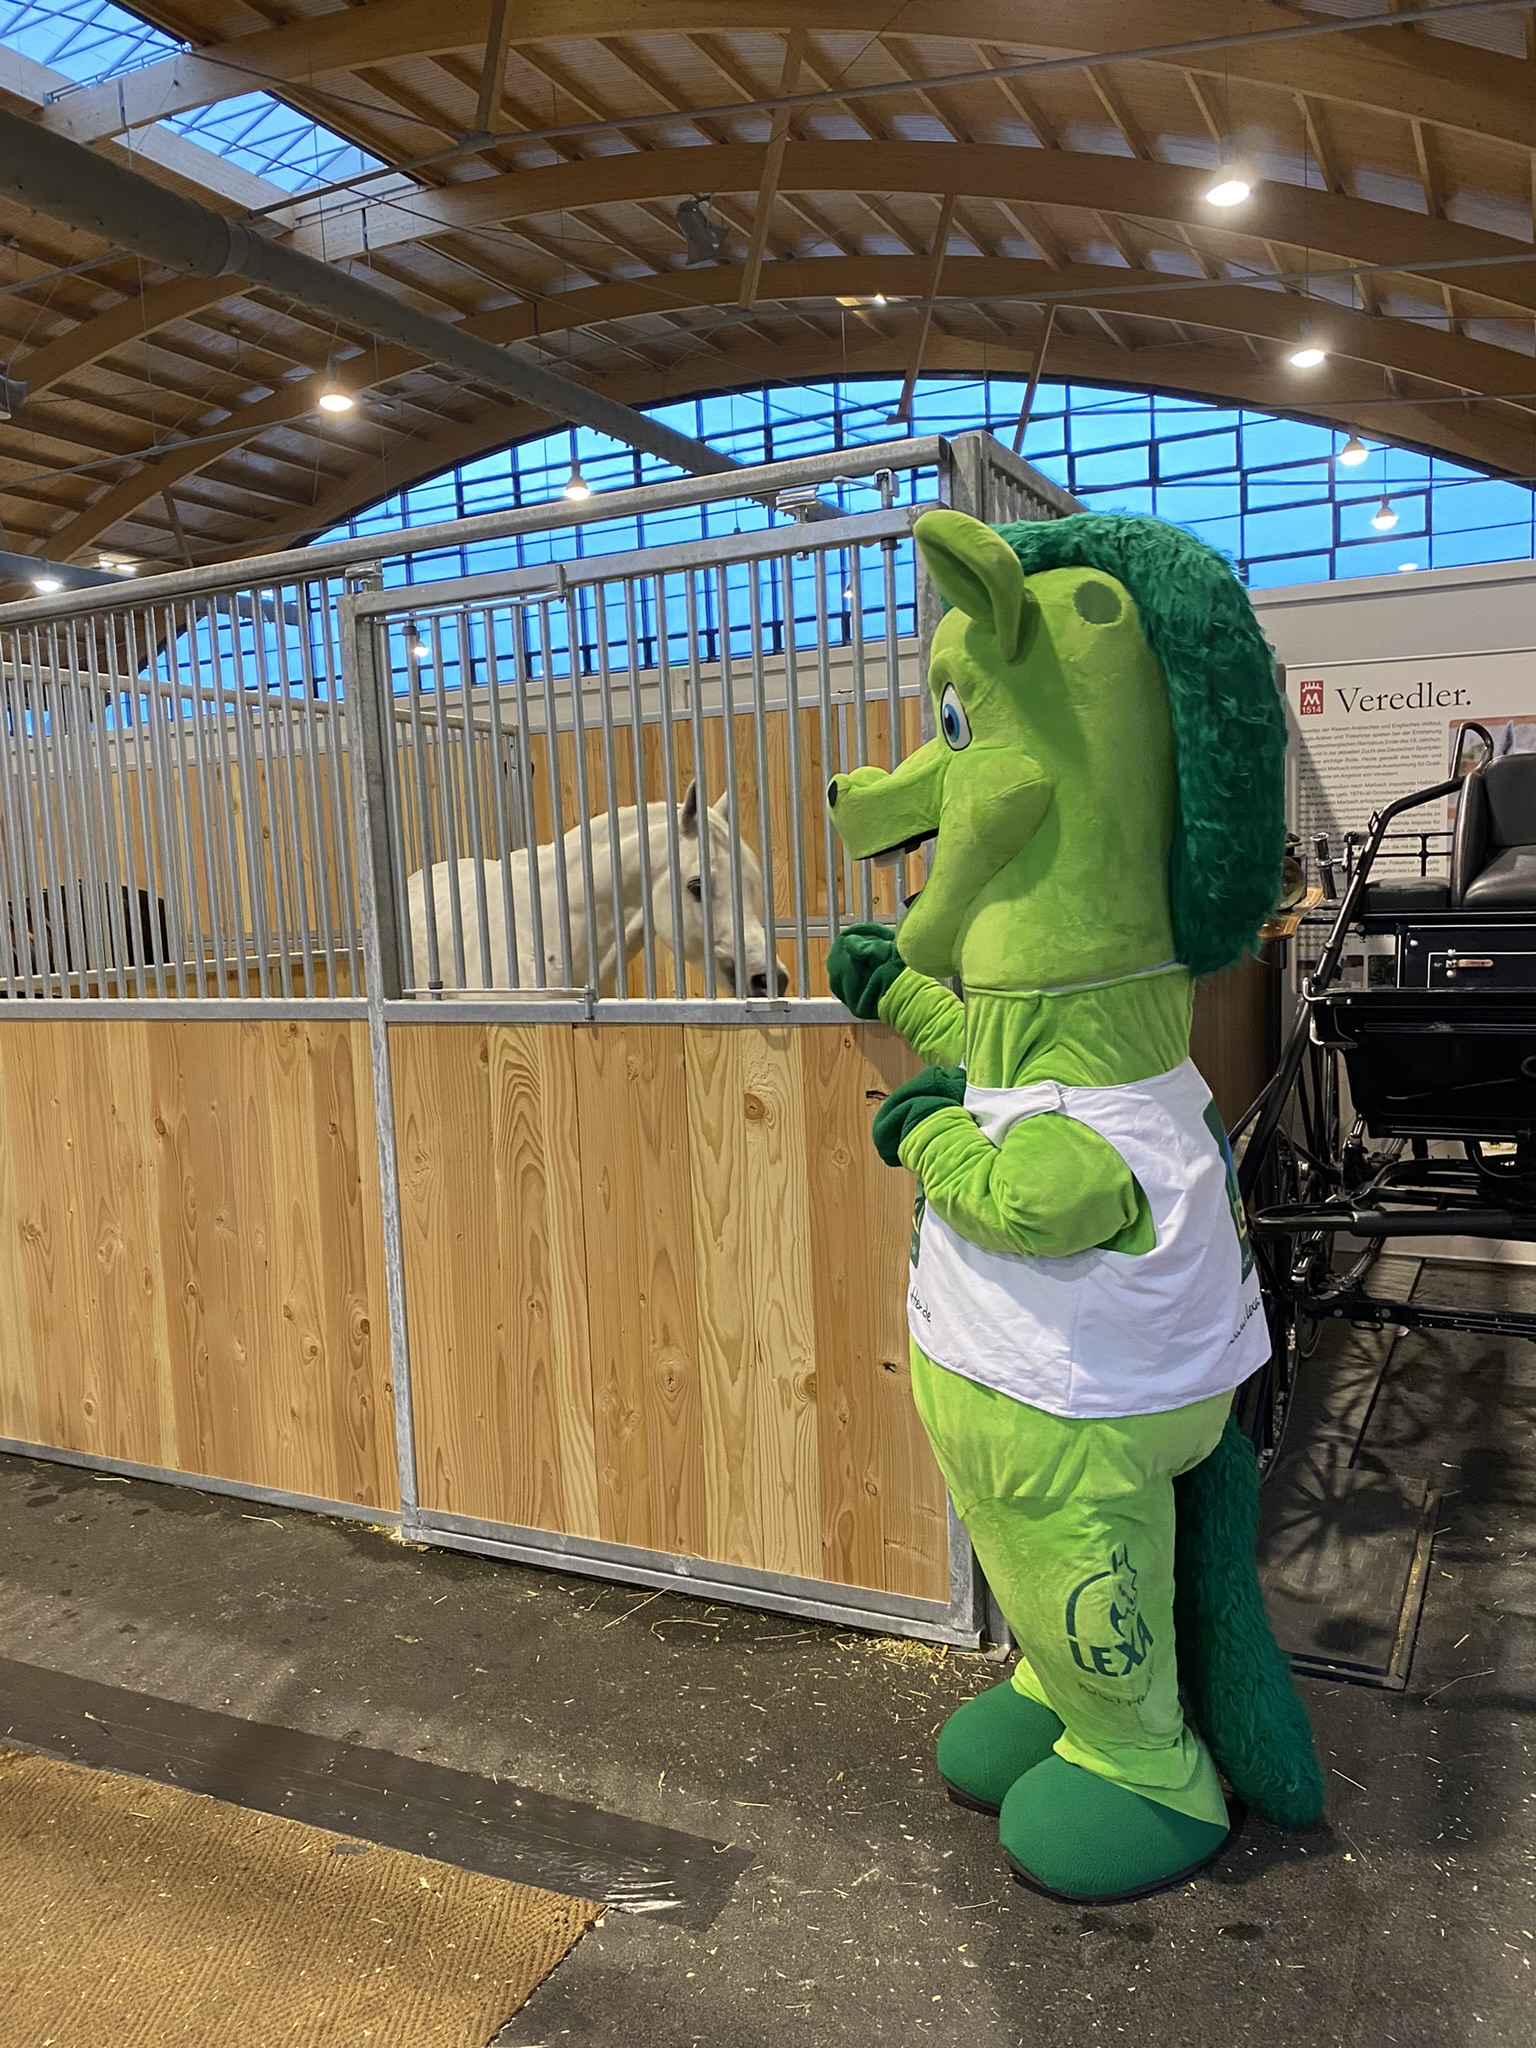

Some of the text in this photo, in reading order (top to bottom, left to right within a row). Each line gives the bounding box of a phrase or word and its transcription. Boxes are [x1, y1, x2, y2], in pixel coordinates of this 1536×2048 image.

[1304, 693, 1320, 706] M
[1335, 681, 1472, 714] Veredler.
[1302, 706, 1322, 714] 1514
[1069, 1612, 1154, 1677] LEXA
